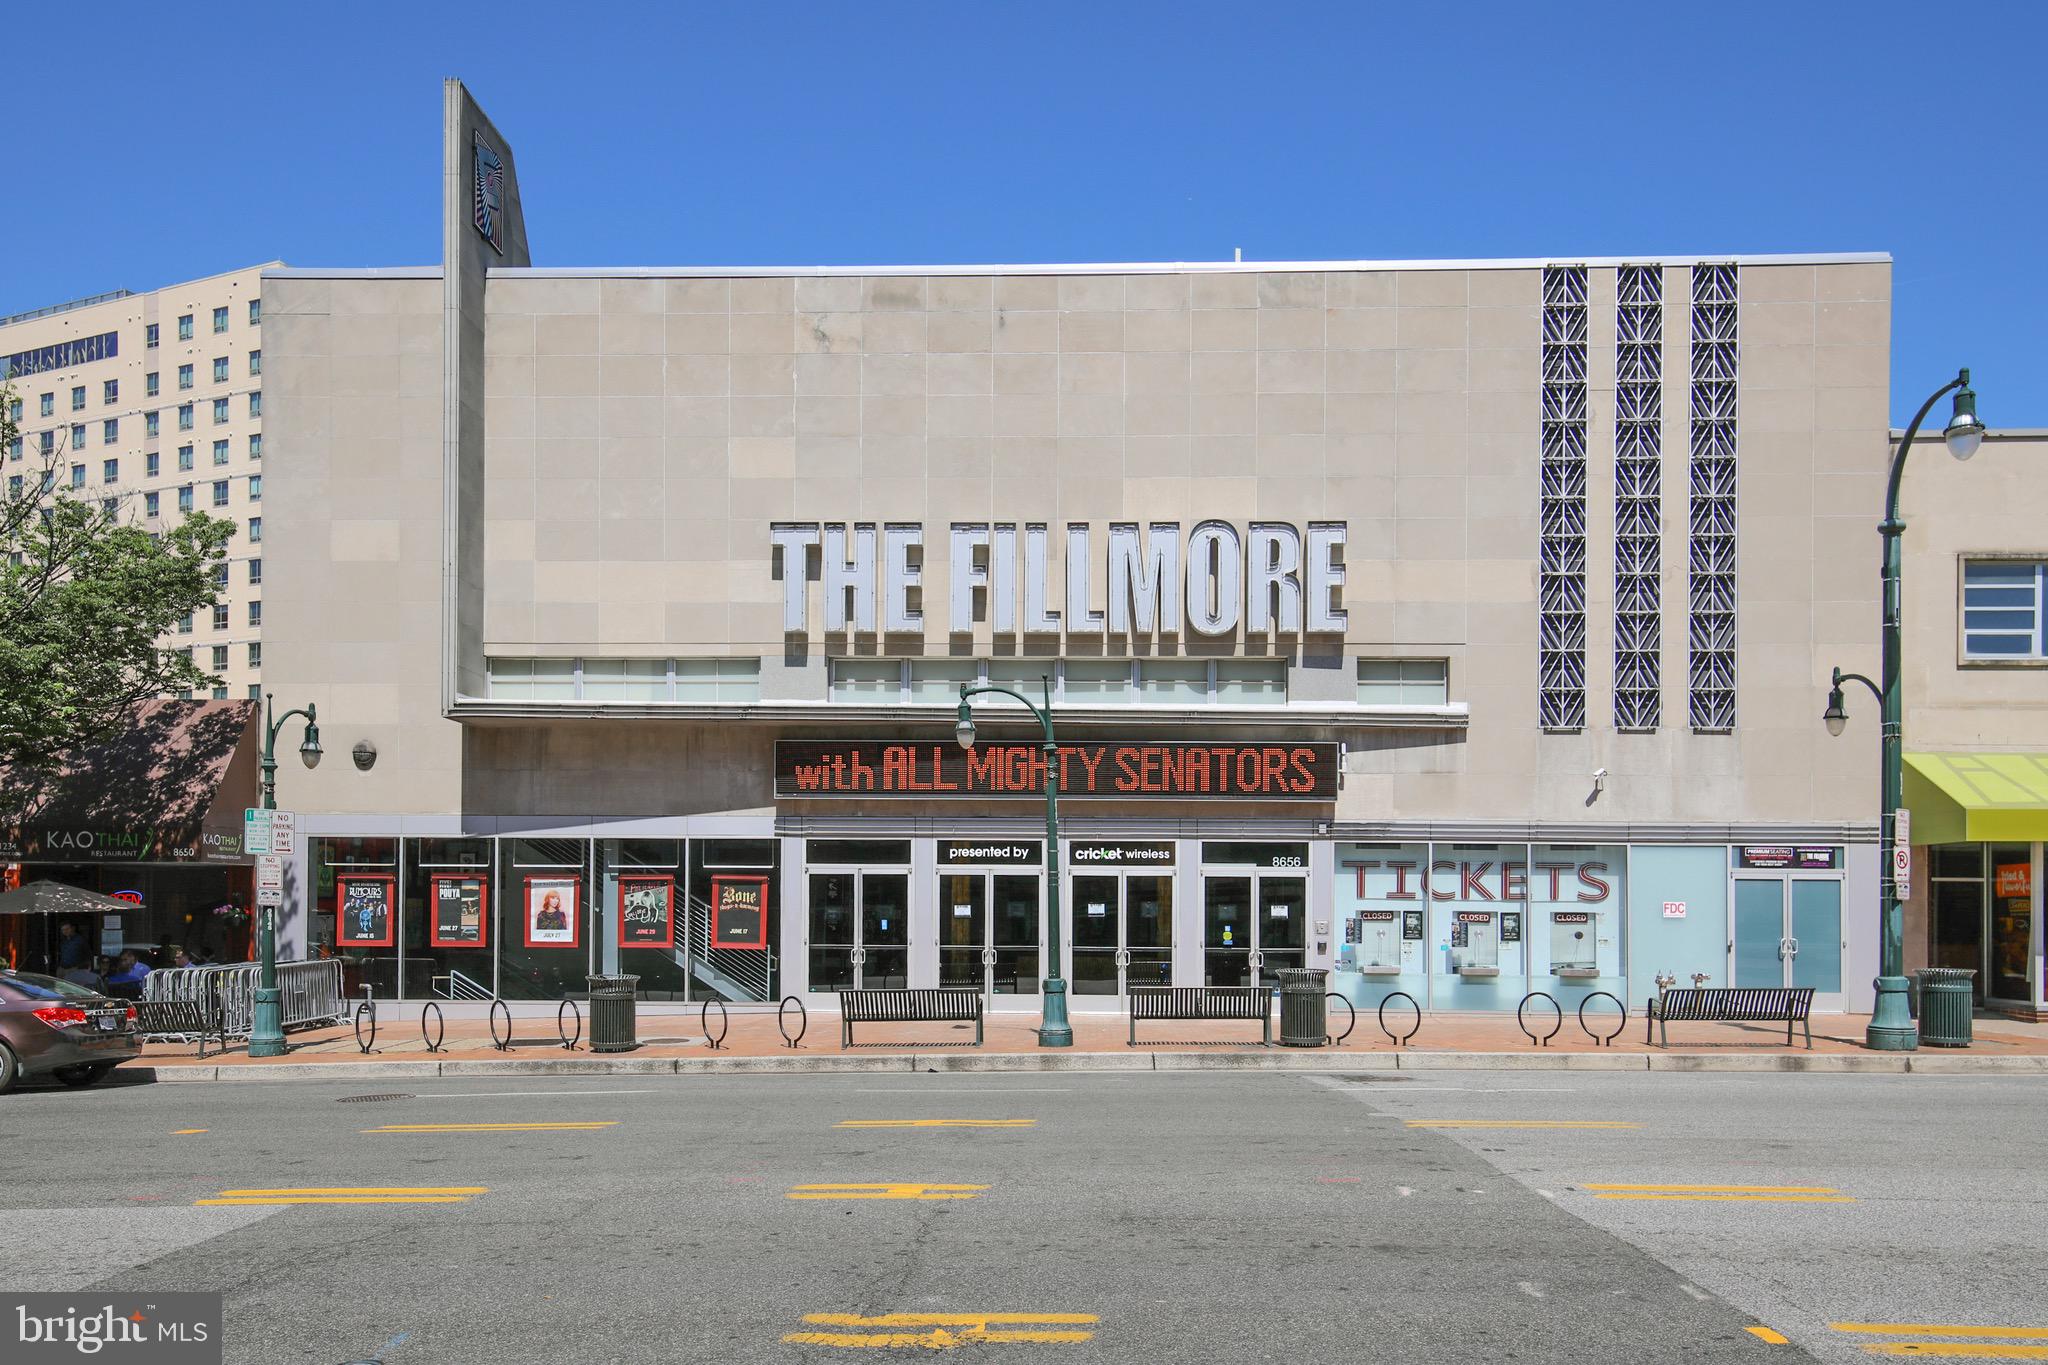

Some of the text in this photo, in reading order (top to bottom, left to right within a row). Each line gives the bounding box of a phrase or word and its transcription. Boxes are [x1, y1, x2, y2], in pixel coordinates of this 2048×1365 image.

[771, 519, 1348, 635] THE FILLMORE
[795, 747, 1316, 792] with ALL MIGHTY SENATORS
[272, 823, 293, 831] PARKING
[173, 847, 195, 857] 8650
[949, 846, 1029, 860] presented by
[1075, 847, 1170, 860] cricket wireless
[1272, 857, 1301, 867] 8656
[1342, 860, 1611, 902] TICKETS
[349, 887, 383, 898] RUMOURS
[440, 888, 460, 898] POUYA
[722, 886, 757, 904] Bone
[1663, 903, 1685, 914] FDC
[1362, 912, 1393, 920] CLOSED
[1459, 913, 1490, 922] CLOSED
